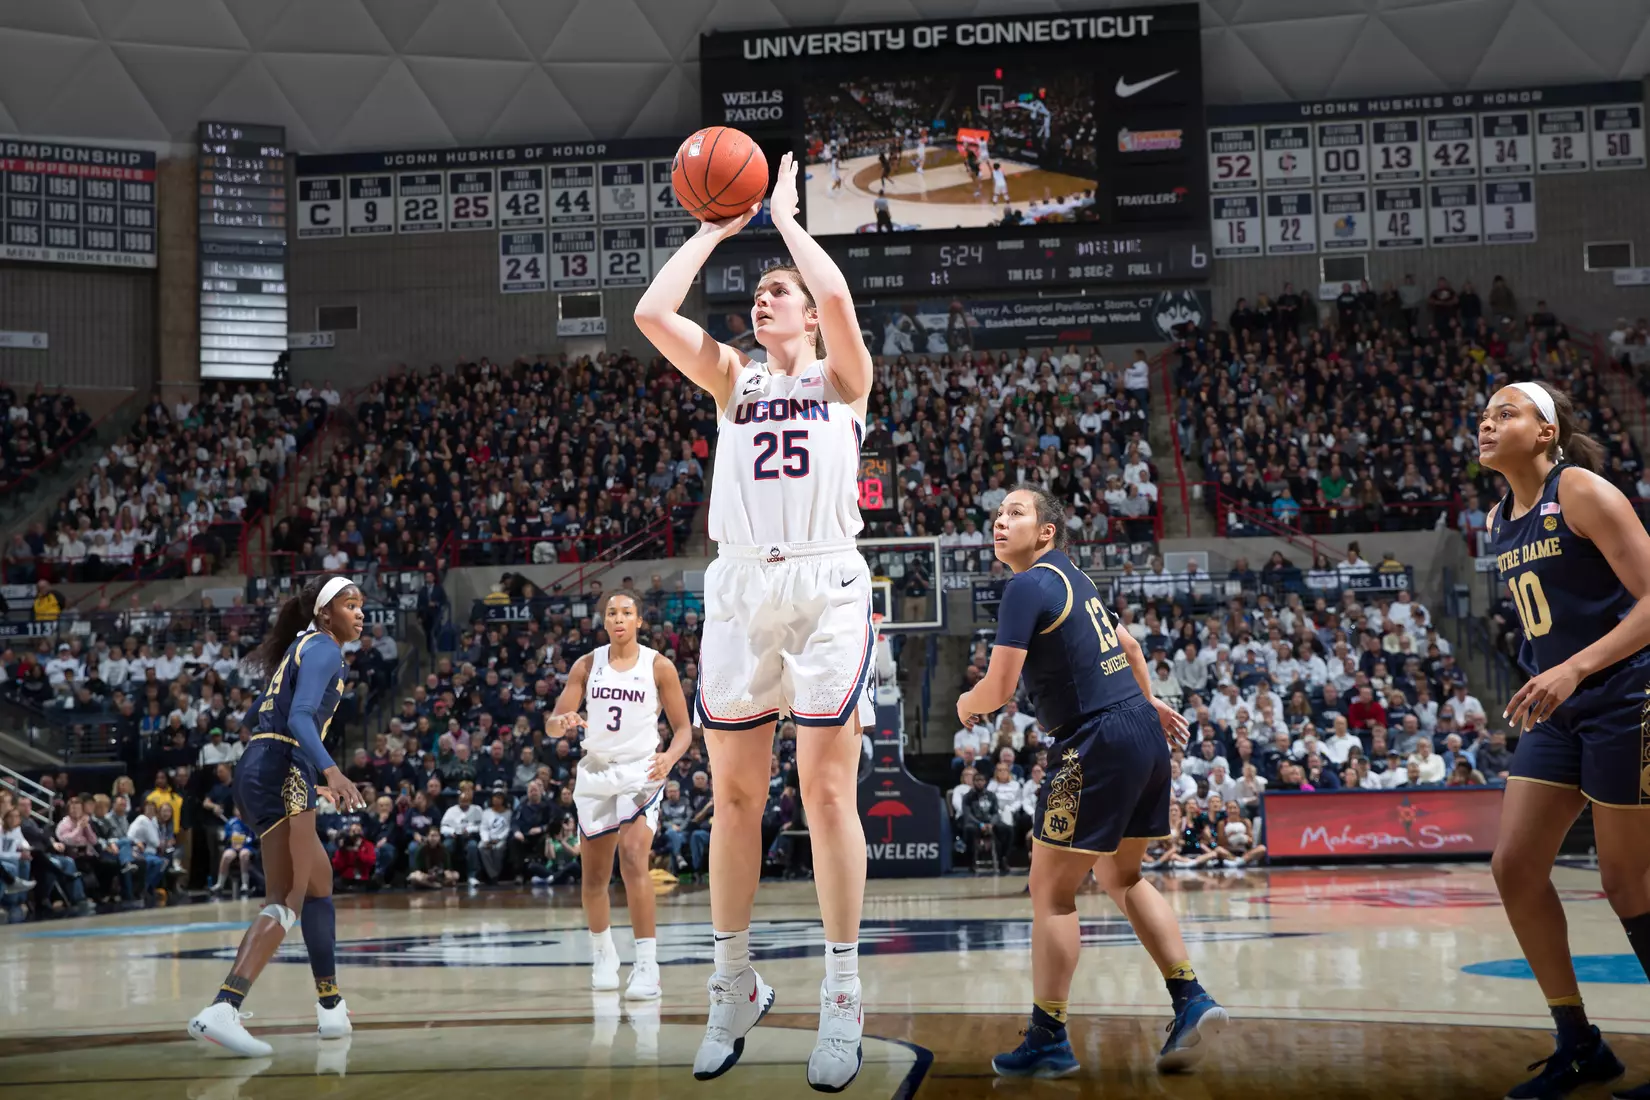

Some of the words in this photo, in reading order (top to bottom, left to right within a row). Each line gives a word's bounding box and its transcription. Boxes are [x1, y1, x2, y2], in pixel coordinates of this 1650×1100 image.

[743, 29, 906, 60] UNIVERSITY
[912, 24, 947, 48] OF
[955, 15, 1154, 46] CONNECTICUT
[722, 90, 783, 106] WELLS
[1301, 103, 1359, 115] UCONN
[1368, 97, 1444, 111] HUSKIES
[1453, 95, 1474, 107] OF
[1483, 91, 1543, 104] HONOR
[724, 106, 783, 122] FARGO
[384, 154, 438, 166] UCONN
[446, 148, 516, 163] HUSKIES
[525, 147, 544, 159] OF
[553, 144, 607, 157] HONOR
[1433, 143, 1470, 166] 42
[1495, 139, 1518, 163] 34
[1552, 136, 1573, 160] 32
[1607, 133, 1631, 156] 50
[1216, 155, 1252, 179] 52
[1325, 148, 1360, 173] 00
[1381, 146, 1412, 169] 13
[454, 196, 489, 219] 25
[505, 193, 540, 215] 42
[555, 190, 590, 213] 44
[657, 186, 683, 208] 4
[1116, 193, 1177, 206] TRAVELERS
[310, 204, 331, 225] C
[364, 200, 378, 223] 9
[404, 198, 438, 221] 22
[1444, 209, 1467, 233] 13
[1504, 207, 1514, 230] 3
[1228, 221, 1246, 244] 15
[1280, 218, 1302, 242] 22
[1388, 212, 1411, 236] 42
[560, 254, 588, 277] 13
[609, 252, 641, 276] 22
[940, 245, 983, 267] 5:24
[506, 257, 540, 281] 24
[1128, 263, 1151, 275] FULL
[972, 305, 998, 318] Harry
[1014, 302, 1053, 316] Gampel
[1055, 300, 1095, 312] Pavilion
[1138, 298, 1153, 308] CT
[580, 321, 604, 332] 214
[985, 314, 1037, 329] Basketball
[1039, 313, 1074, 327] Capital
[1076, 314, 1089, 324] of
[1089, 313, 1107, 323] the
[1109, 311, 1141, 322] World
[309, 333, 333, 345] 213
[734, 398, 830, 425] UCONN
[753, 430, 810, 480] 25
[1522, 536, 1563, 564] DAME
[1350, 578, 1371, 588] SEC
[1379, 574, 1408, 588] 116
[975, 590, 995, 599] SEC
[1508, 570, 1553, 642] 10
[369, 610, 396, 624] 113
[503, 606, 531, 620] 114
[1085, 596, 1119, 653] 13
[27, 622, 52, 636] 113
[591, 686, 646, 704] UCONN
[606, 705, 622, 732] 3
[1418, 824, 1473, 849] Sun
[866, 843, 939, 860] AVELERS
